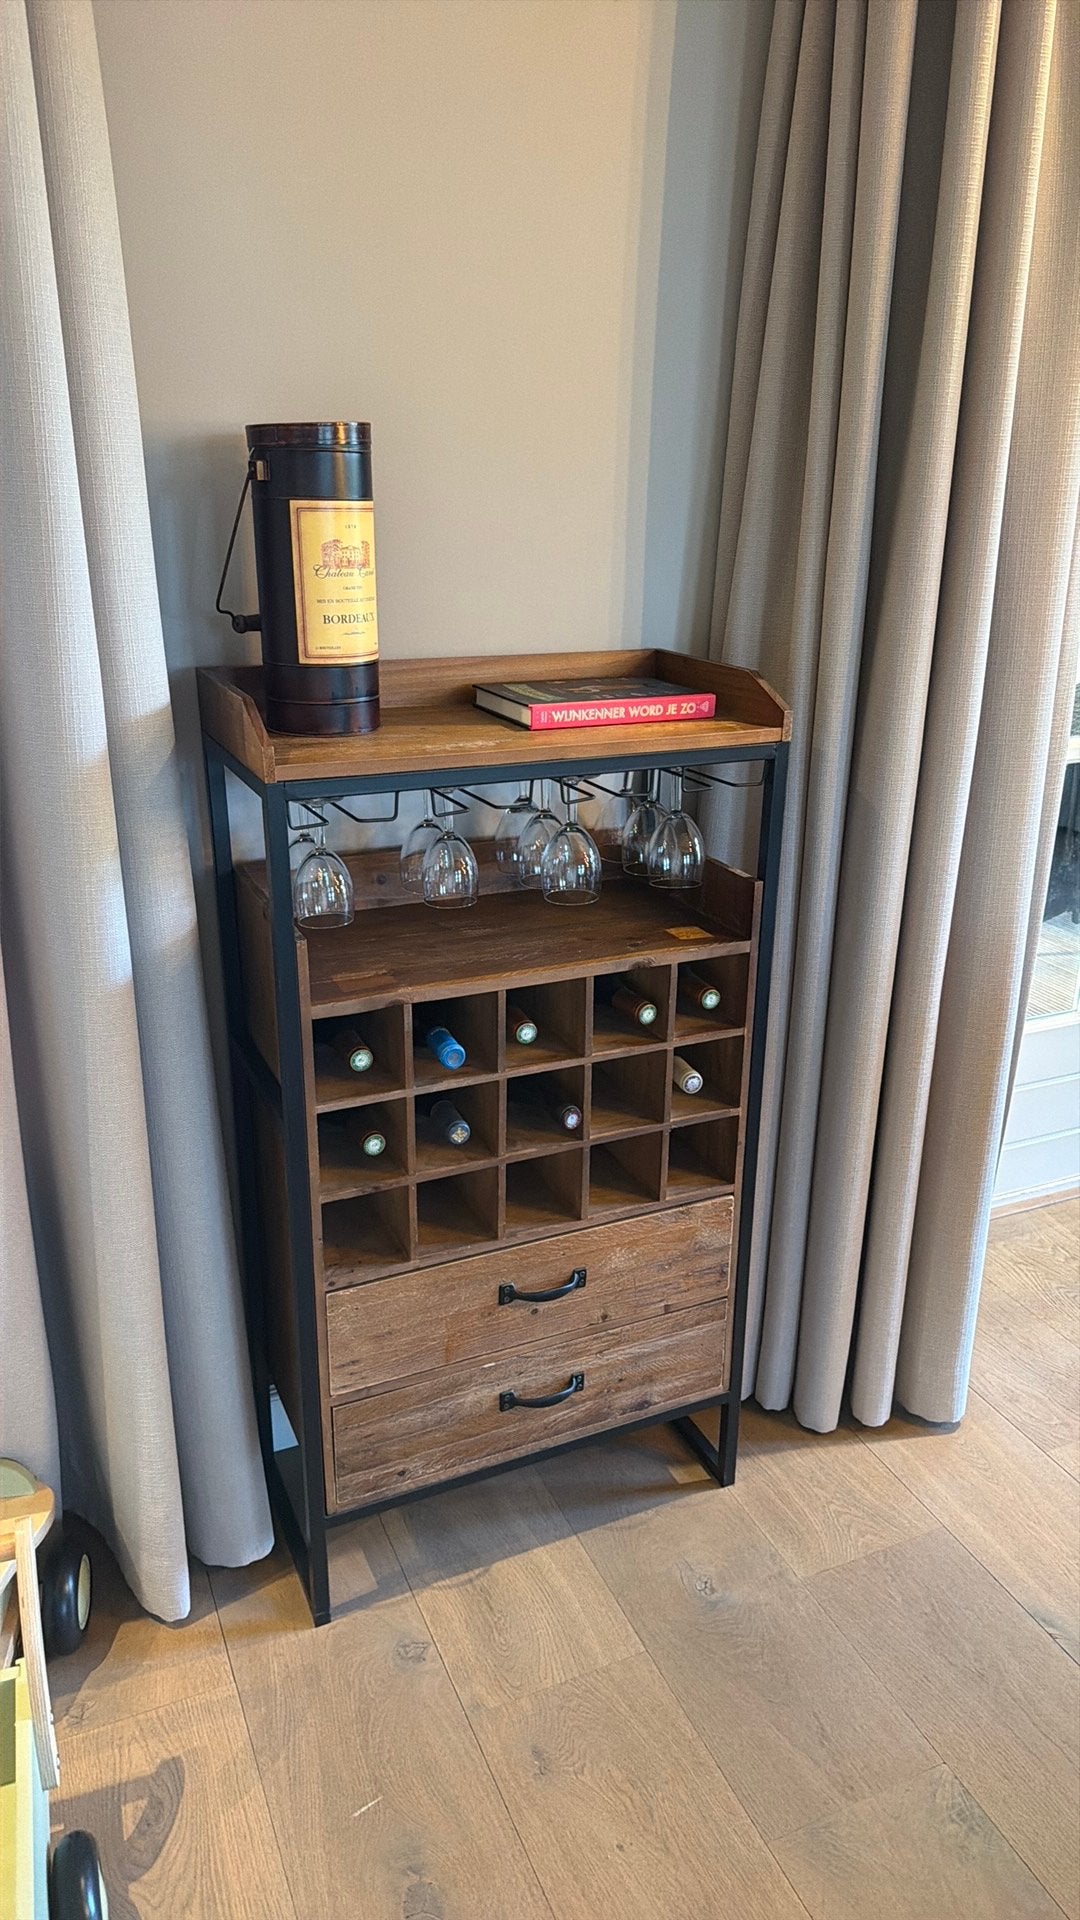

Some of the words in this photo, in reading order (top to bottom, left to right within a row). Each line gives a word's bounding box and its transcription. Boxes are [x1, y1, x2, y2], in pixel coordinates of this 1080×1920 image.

[628, 704, 664, 718] WORD
[666, 703, 678, 716] JE
[680, 702, 697, 715] ZO
